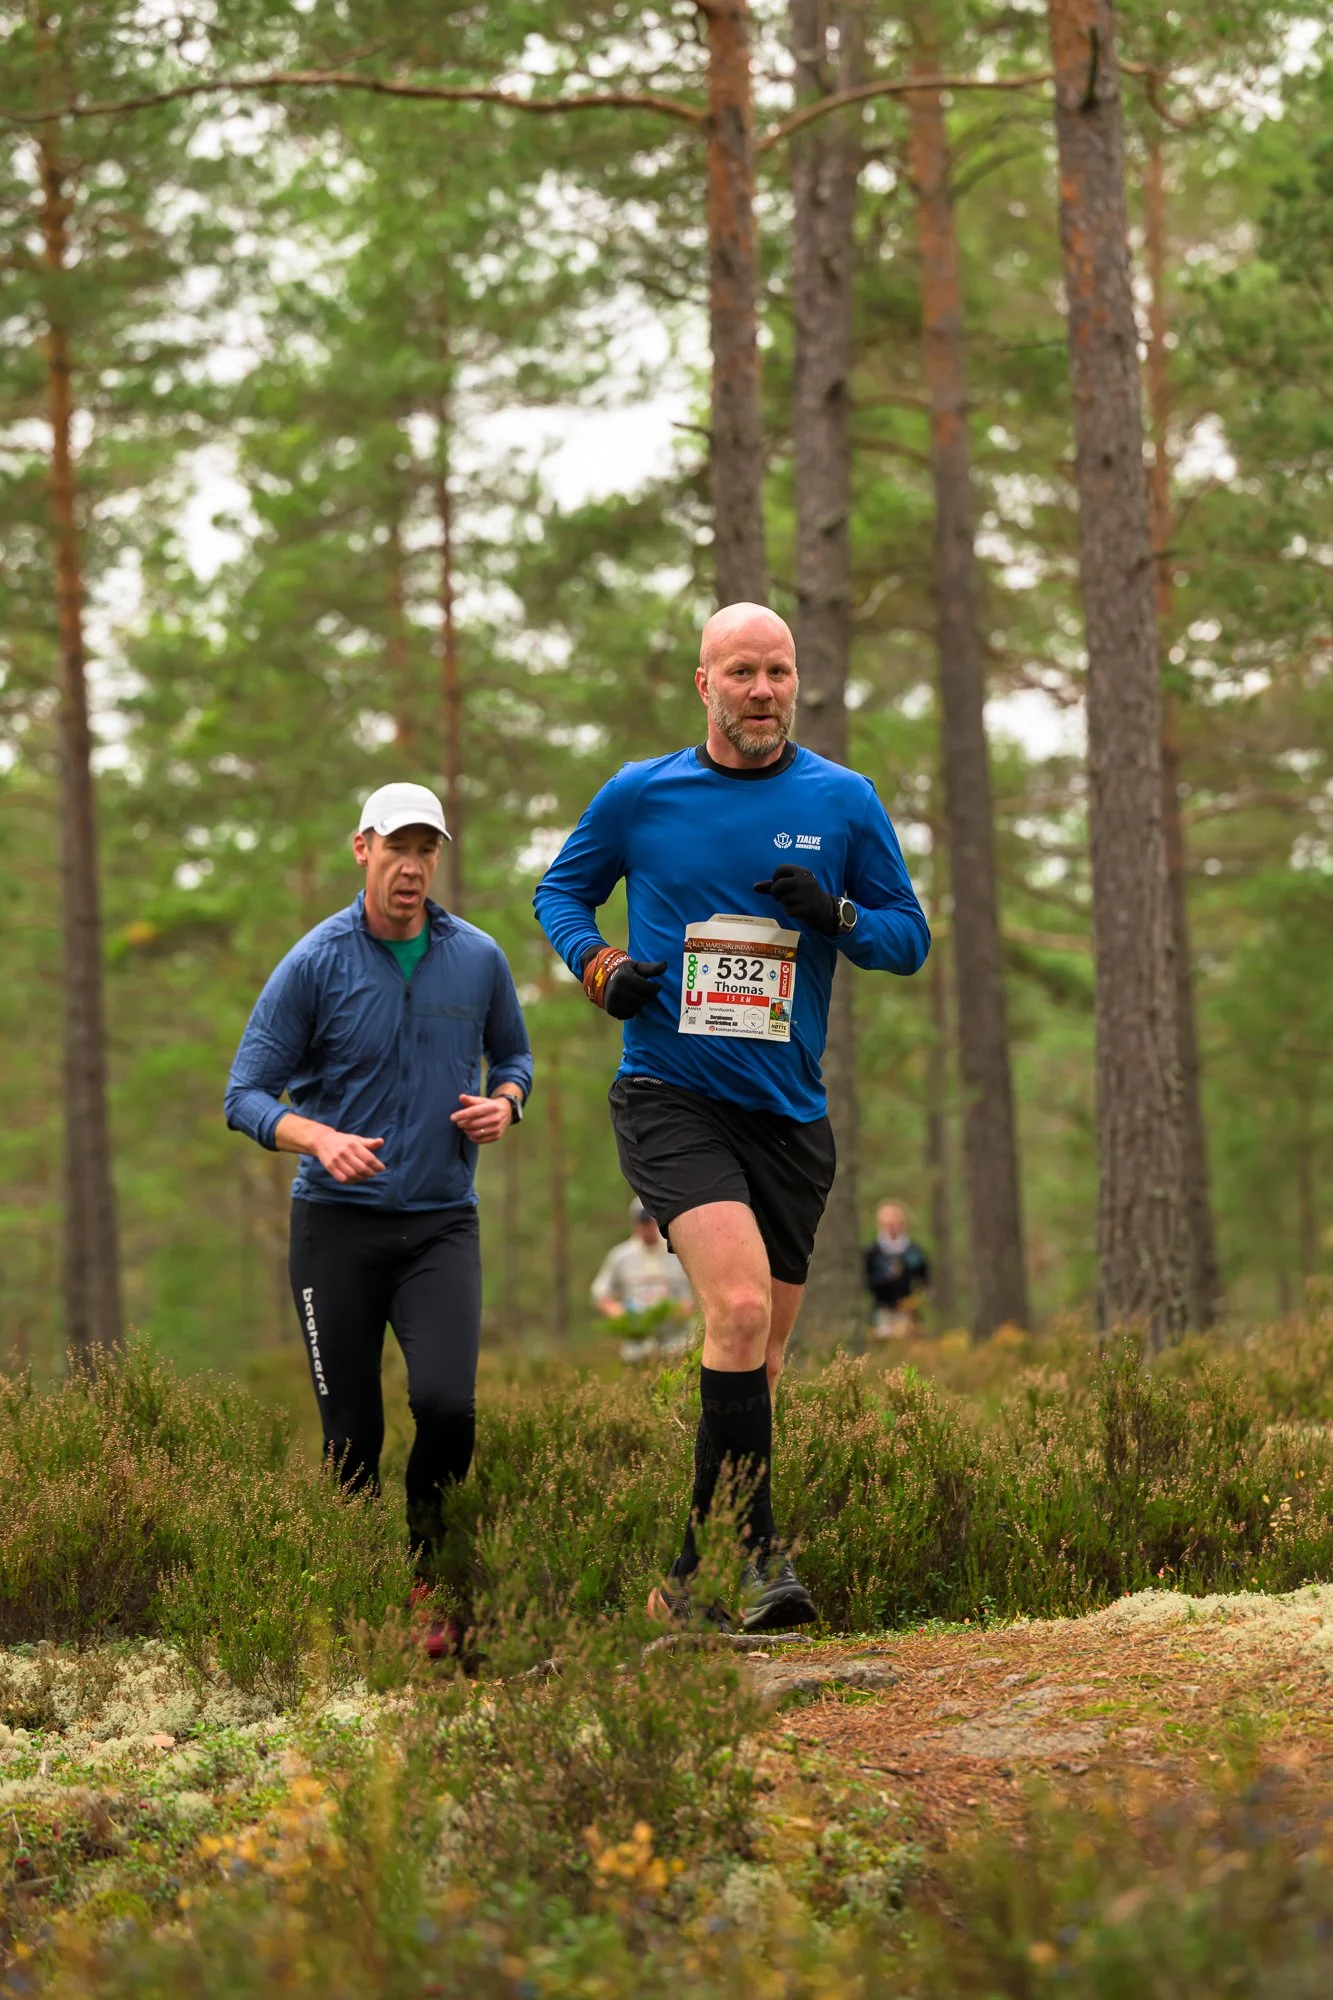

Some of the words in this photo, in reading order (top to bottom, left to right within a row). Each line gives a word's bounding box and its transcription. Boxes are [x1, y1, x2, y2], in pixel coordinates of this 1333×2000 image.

[686, 953, 698, 990] coop
[716, 957, 764, 982] 532
[714, 981, 764, 995] Thomas
